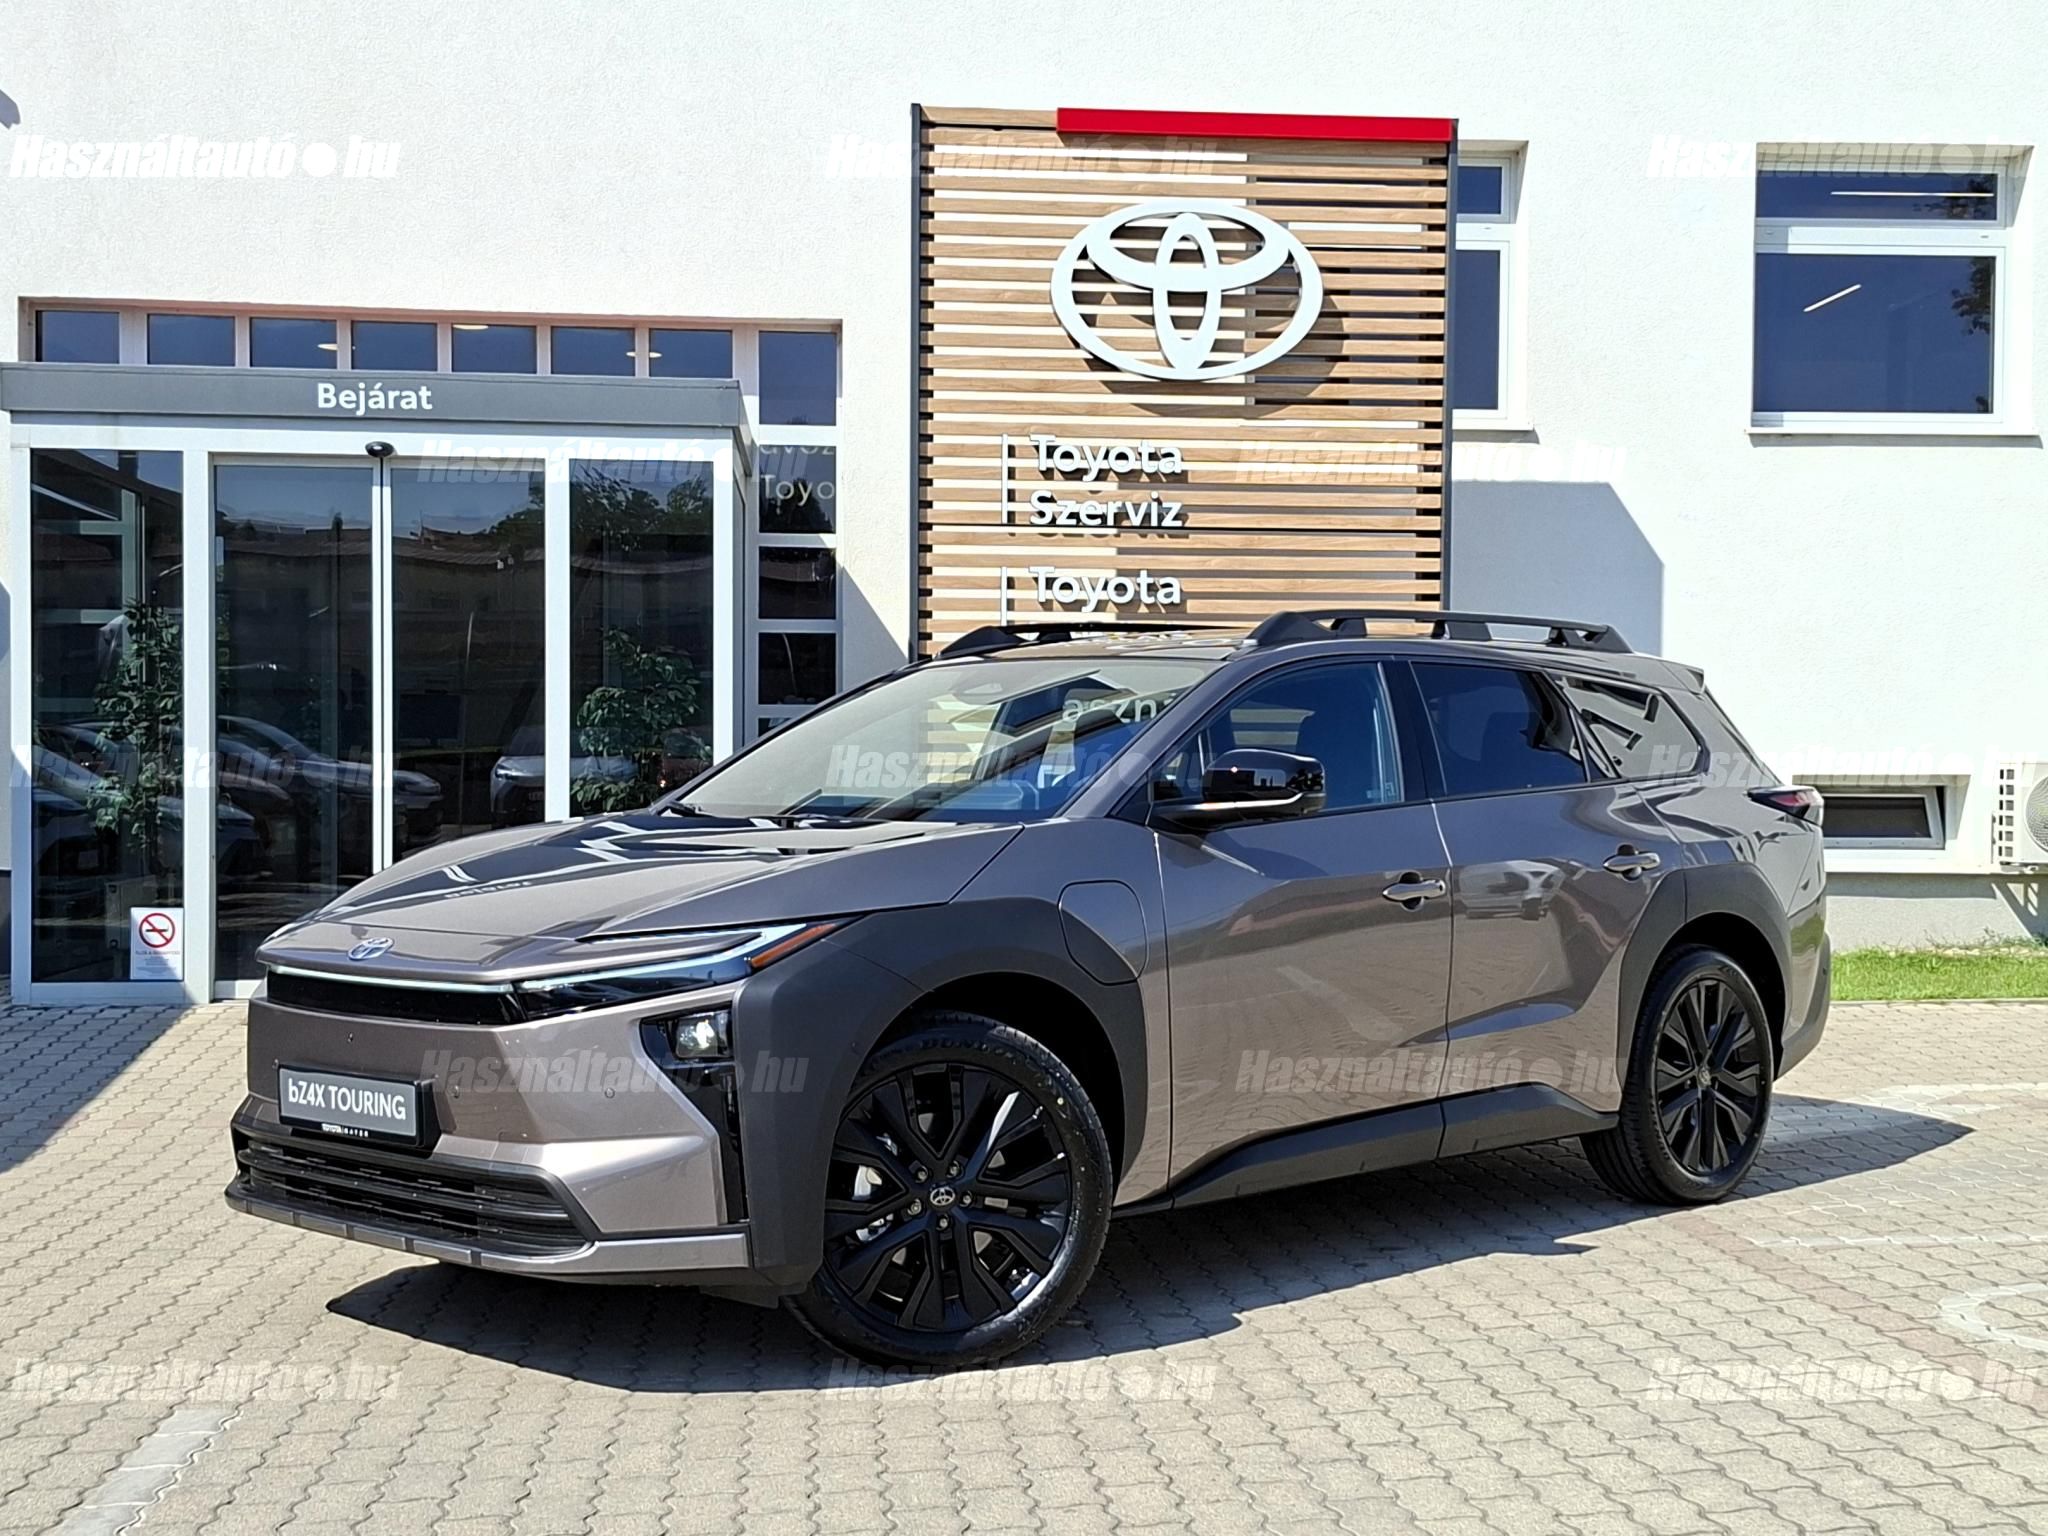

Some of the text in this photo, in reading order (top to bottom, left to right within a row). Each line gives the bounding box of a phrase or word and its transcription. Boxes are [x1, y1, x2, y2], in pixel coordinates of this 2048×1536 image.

[317, 382, 434, 416] Bejárat
[1029, 433, 1183, 482] Toyota
[1029, 490, 1184, 527] Szerviz
[1028, 565, 1182, 613] Toyota
[287, 1077, 407, 1120] bZ4X TOURING
